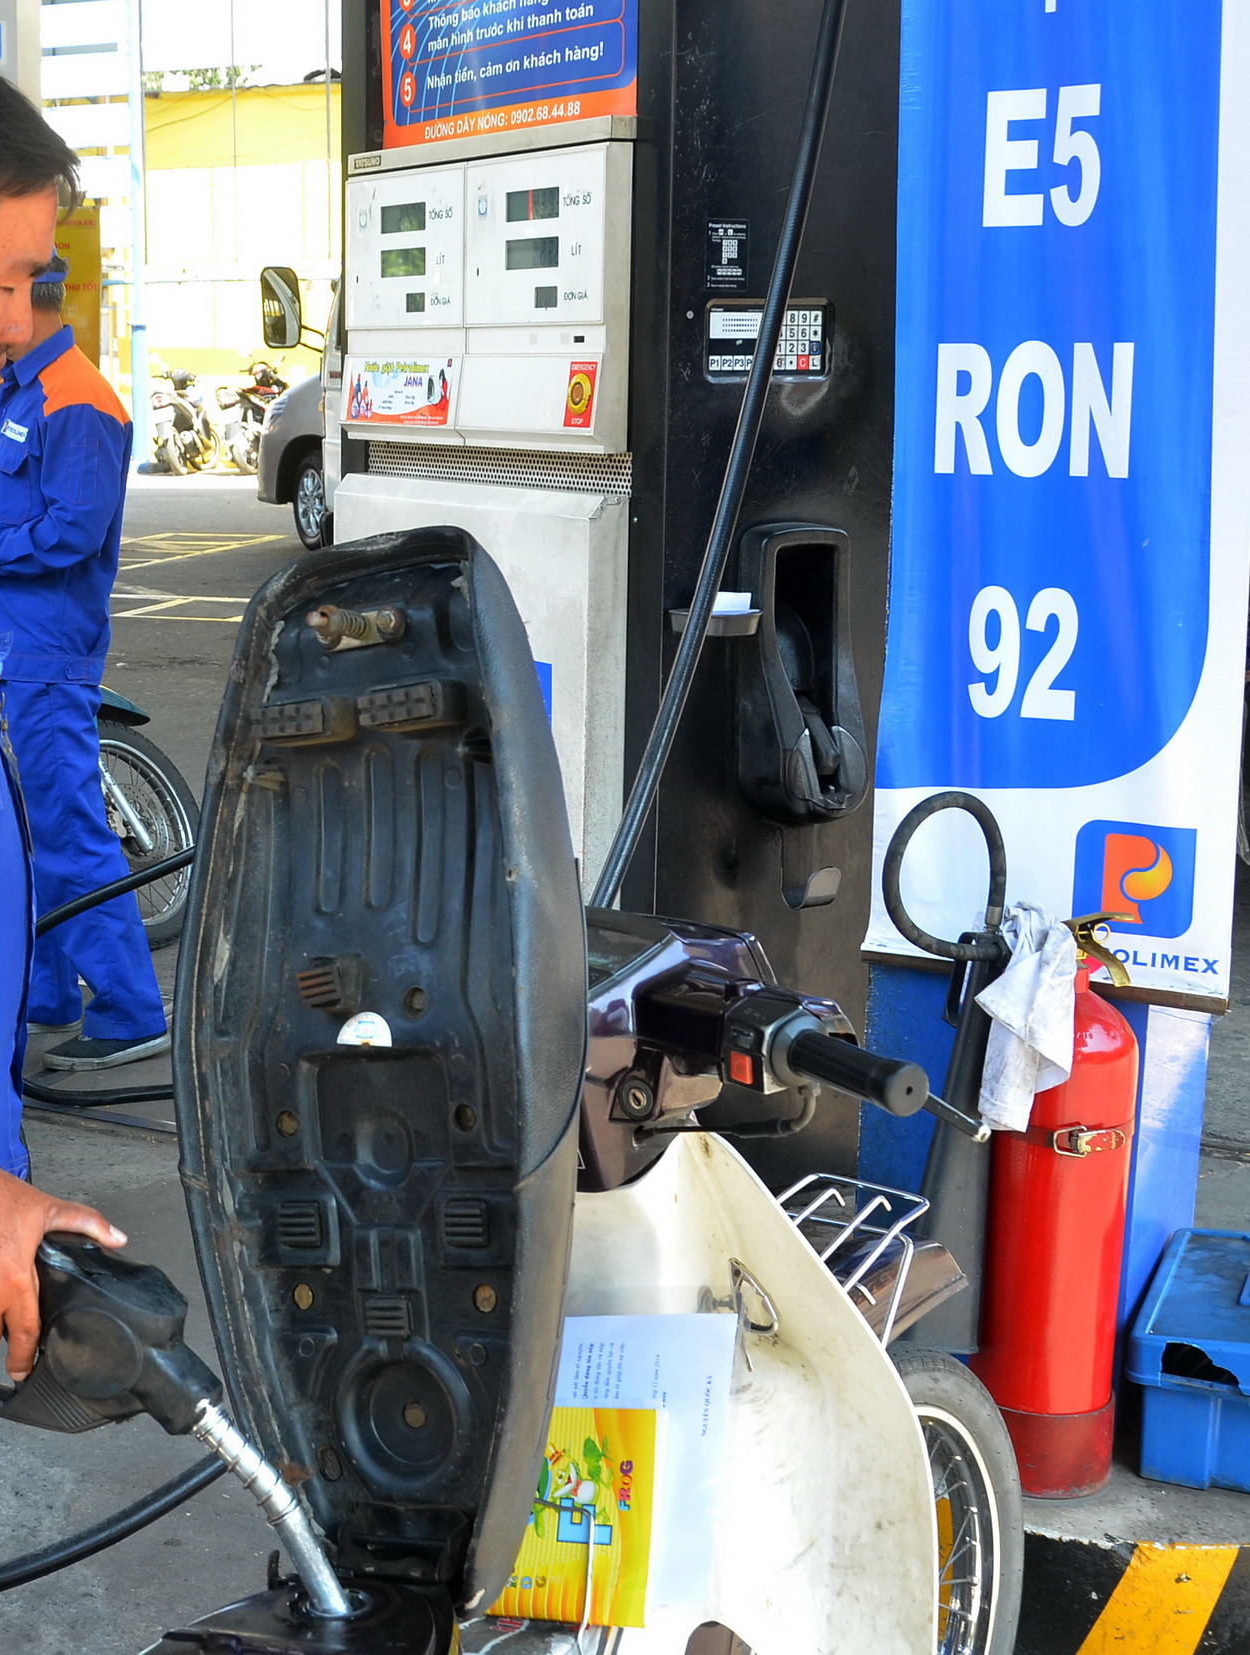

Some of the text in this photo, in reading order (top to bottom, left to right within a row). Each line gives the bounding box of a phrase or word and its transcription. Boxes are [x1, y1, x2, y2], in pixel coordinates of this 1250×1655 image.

[403, 29, 412, 54] 4
[507, 16, 524, 33] khi
[527, 10, 562, 29] thanh
[565, 3, 594, 21] toán
[428, 14, 458, 30] Thông
[461, 6, 480, 22] báo
[403, 77, 412, 102] 5
[427, 72, 452, 89] Nhận
[480, 62, 503, 78] cảm
[505, 59, 520, 73] ơn
[523, 51, 561, 70] khách
[565, 41, 604, 62] hàng!
[510, 101, 581, 124] 0902.68.44.88
[982, 83, 1101, 227] E5
[789, 313, 796, 323] 8
[801, 313, 807, 323] 9
[789, 328, 807, 338] 5 6
[789, 343, 795, 353] 2
[800, 343, 806, 353] 3
[710, 359, 719, 367] P1
[722, 359, 732, 367] P2
[735, 359, 744, 367] P3
[799, 357, 806, 368] C
[812, 358, 818, 367] L
[404, 376, 423, 387] JANA
[934, 339, 1135, 478] RON
[571, 417, 584, 425] STOP
[968, 585, 1079, 721] 92
[1105, 947, 1219, 975] OLIMEX
[618, 1460, 634, 1511] FROG
